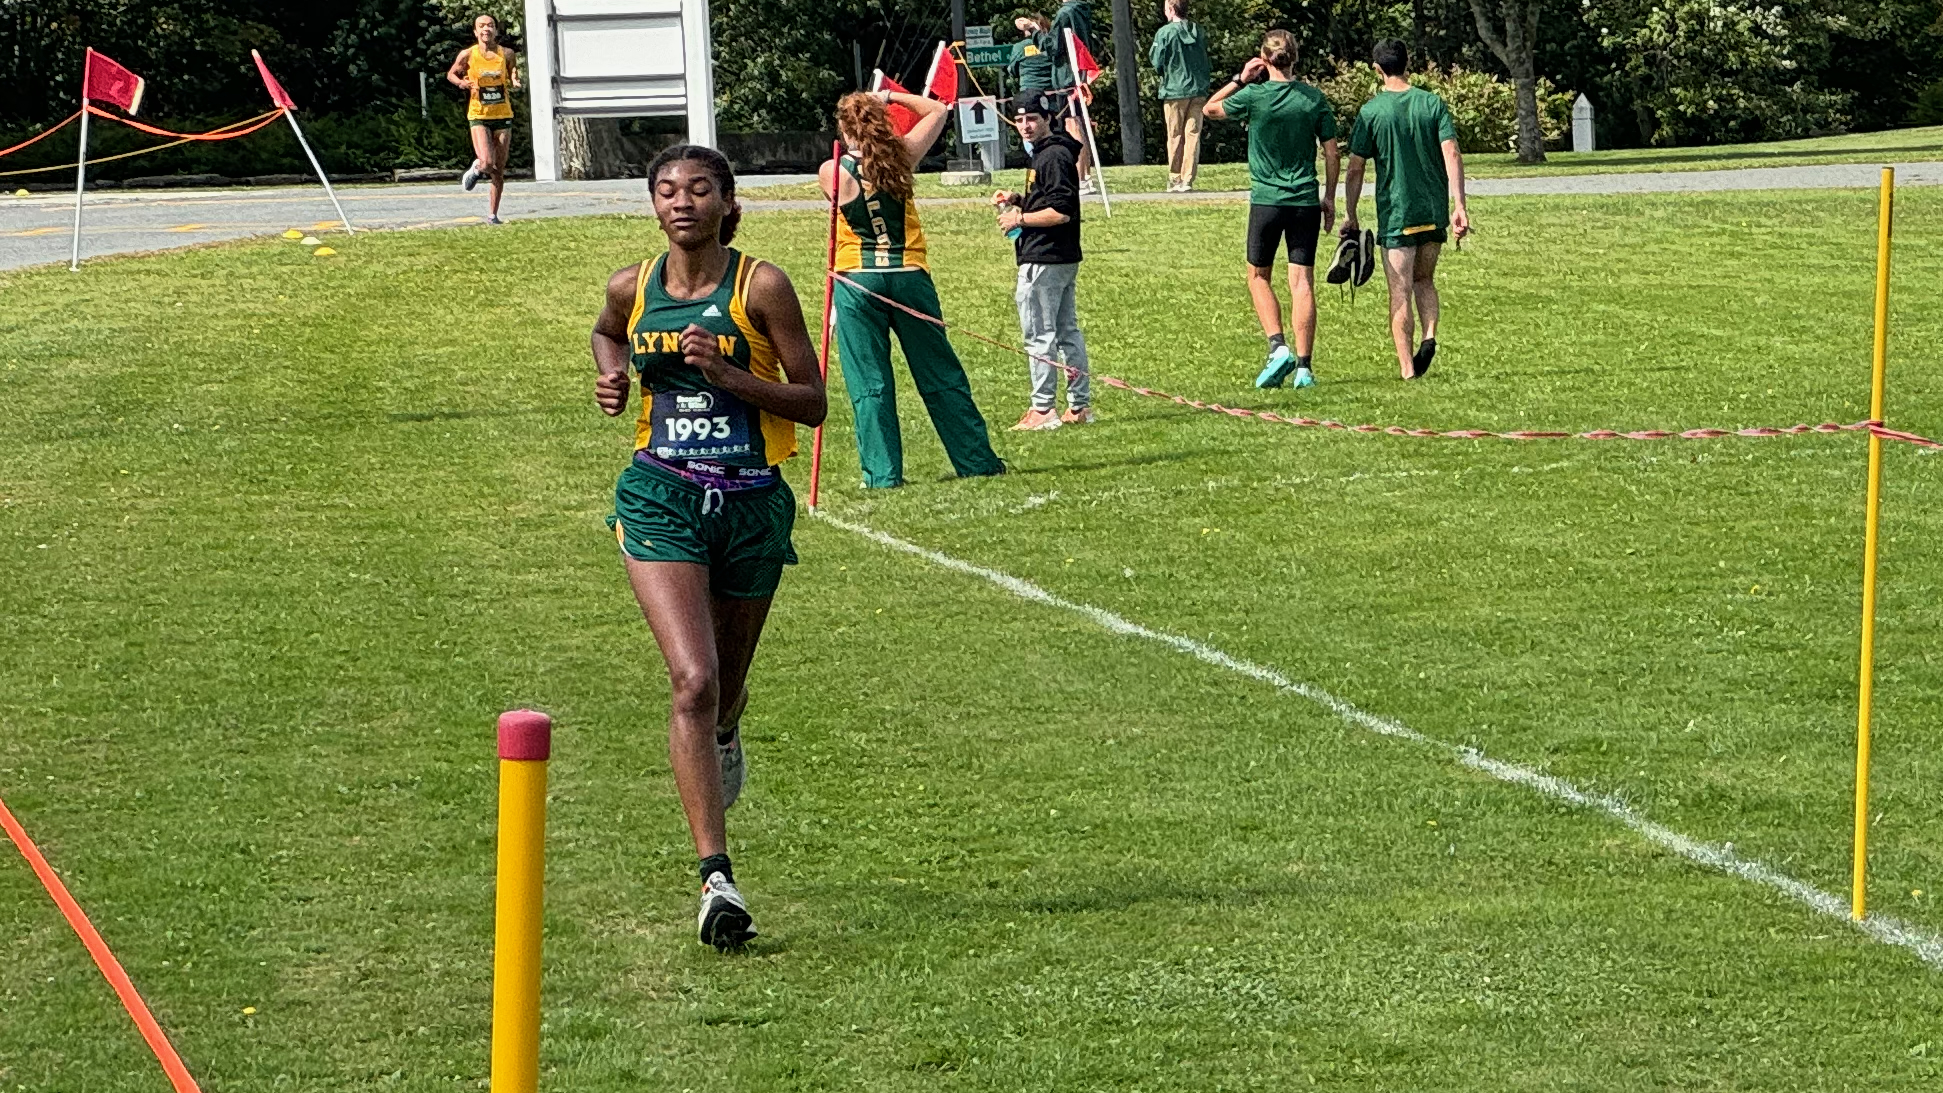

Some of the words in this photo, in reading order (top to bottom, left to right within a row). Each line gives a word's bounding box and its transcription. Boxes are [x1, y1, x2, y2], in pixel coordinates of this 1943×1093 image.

[966, 50, 1002, 64] Bethel
[632, 331, 738, 357] LYNN
[665, 415, 731, 441] 1993
